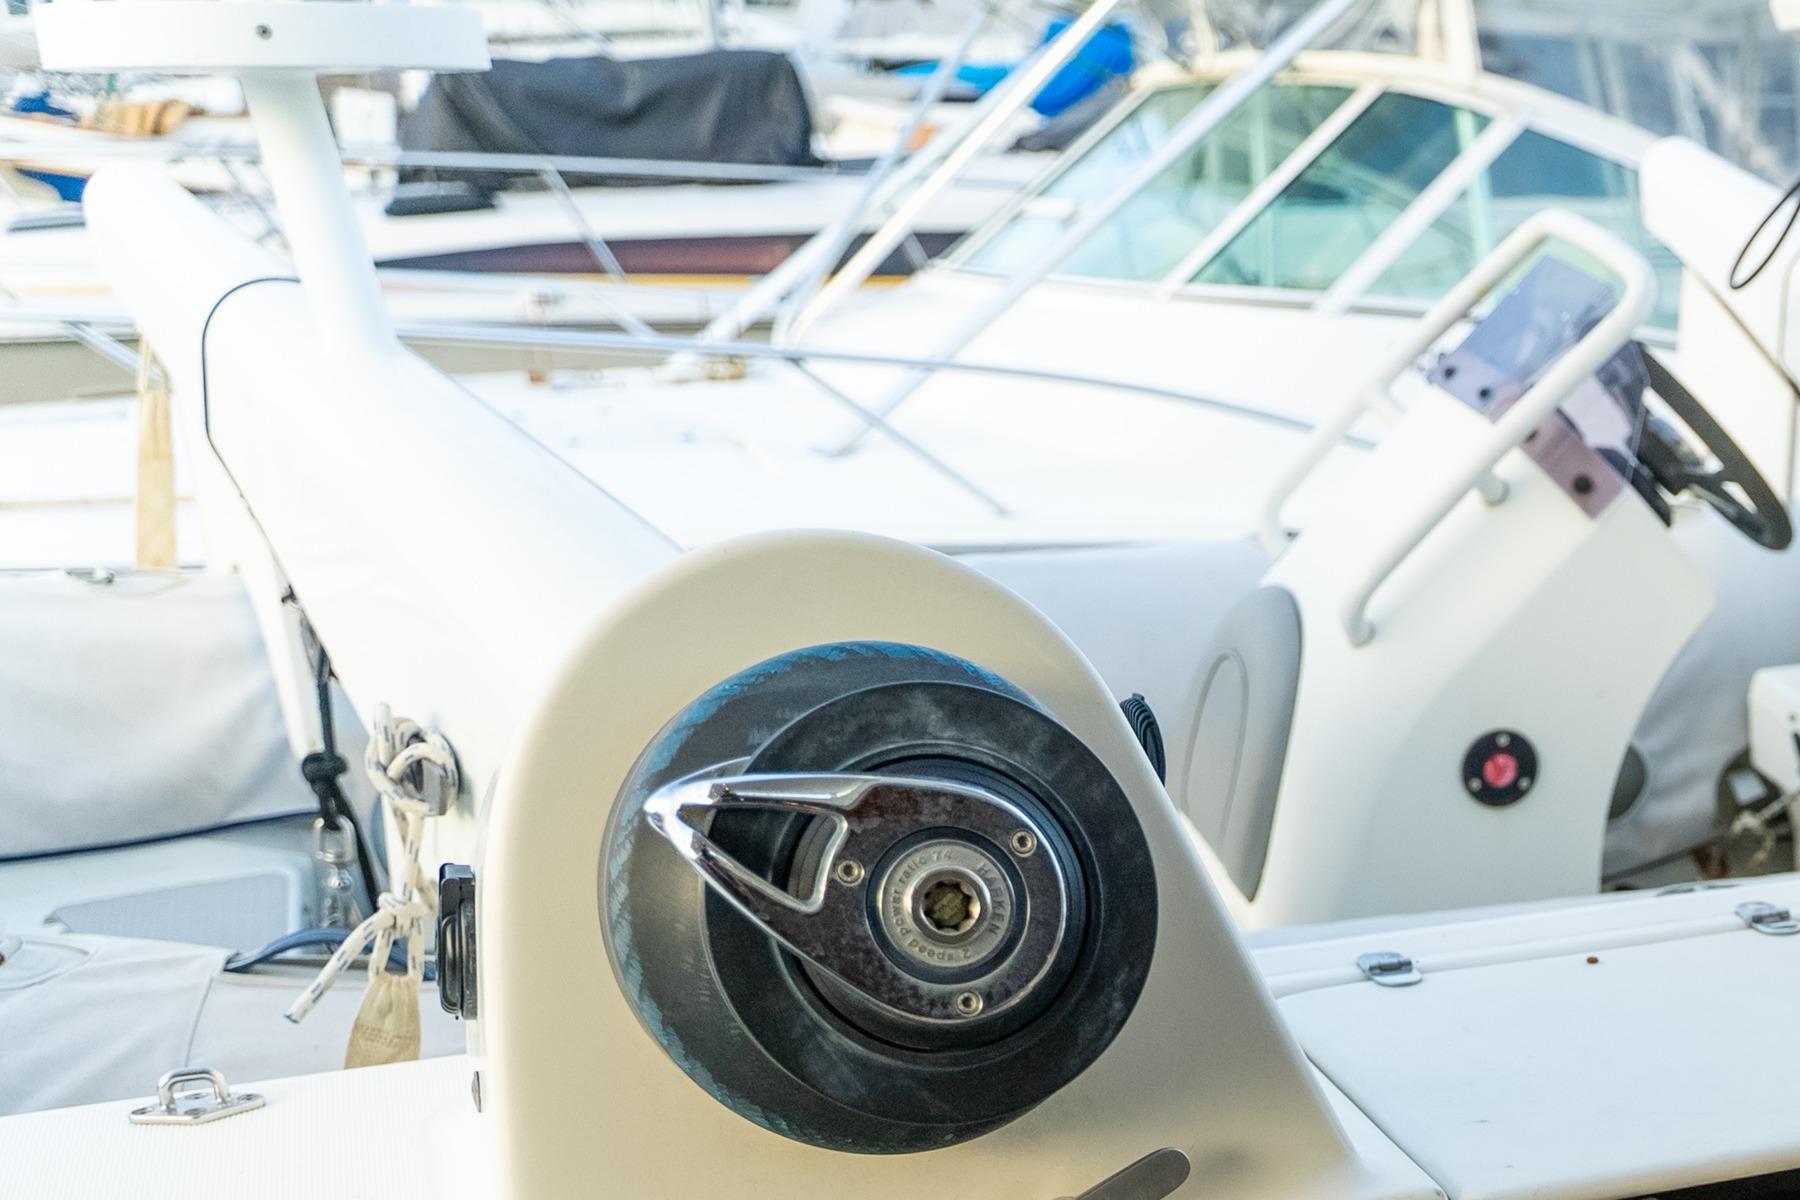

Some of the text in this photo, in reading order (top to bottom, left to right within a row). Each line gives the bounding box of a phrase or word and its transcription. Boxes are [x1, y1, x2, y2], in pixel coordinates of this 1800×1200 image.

[898, 857, 928, 884] ratio
[891, 889, 910, 935] power
[976, 863, 1006, 935] HARKEN
[907, 938, 955, 961] speed
